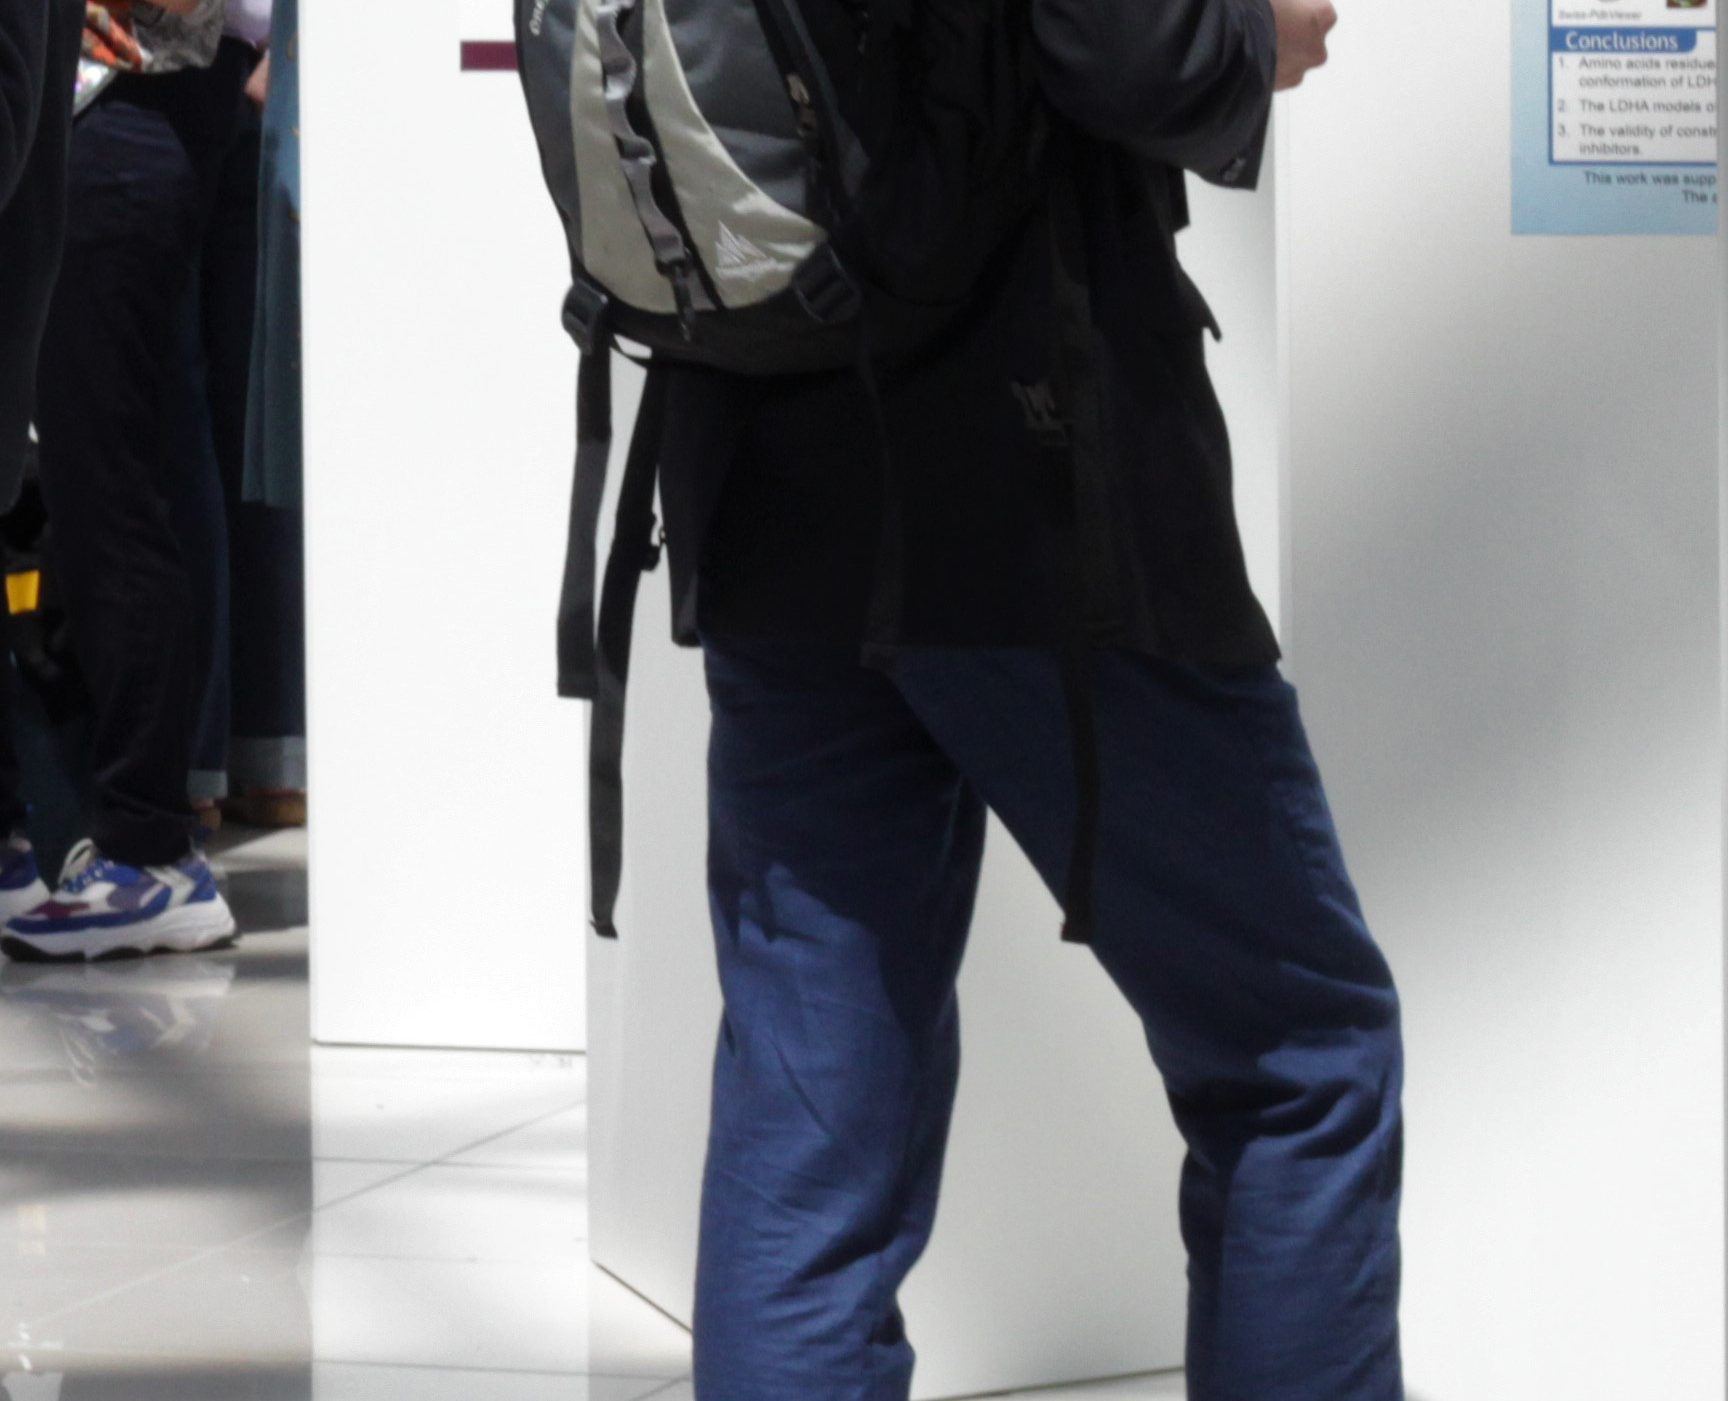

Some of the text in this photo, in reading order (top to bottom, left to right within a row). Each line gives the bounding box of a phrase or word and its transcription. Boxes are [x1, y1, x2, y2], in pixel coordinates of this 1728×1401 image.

[1566, 31, 1679, 50] Conclusions
[1579, 57, 1660, 69] Amino acids
[1579, 76, 1666, 88] conformation
[1580, 99, 1604, 112] The
[1610, 99, 1649, 112] LDHA
[1580, 124, 1605, 137] The
[1610, 124, 1655, 140] validity
[1584, 171, 1612, 184] This
[1616, 172, 1647, 184] work
